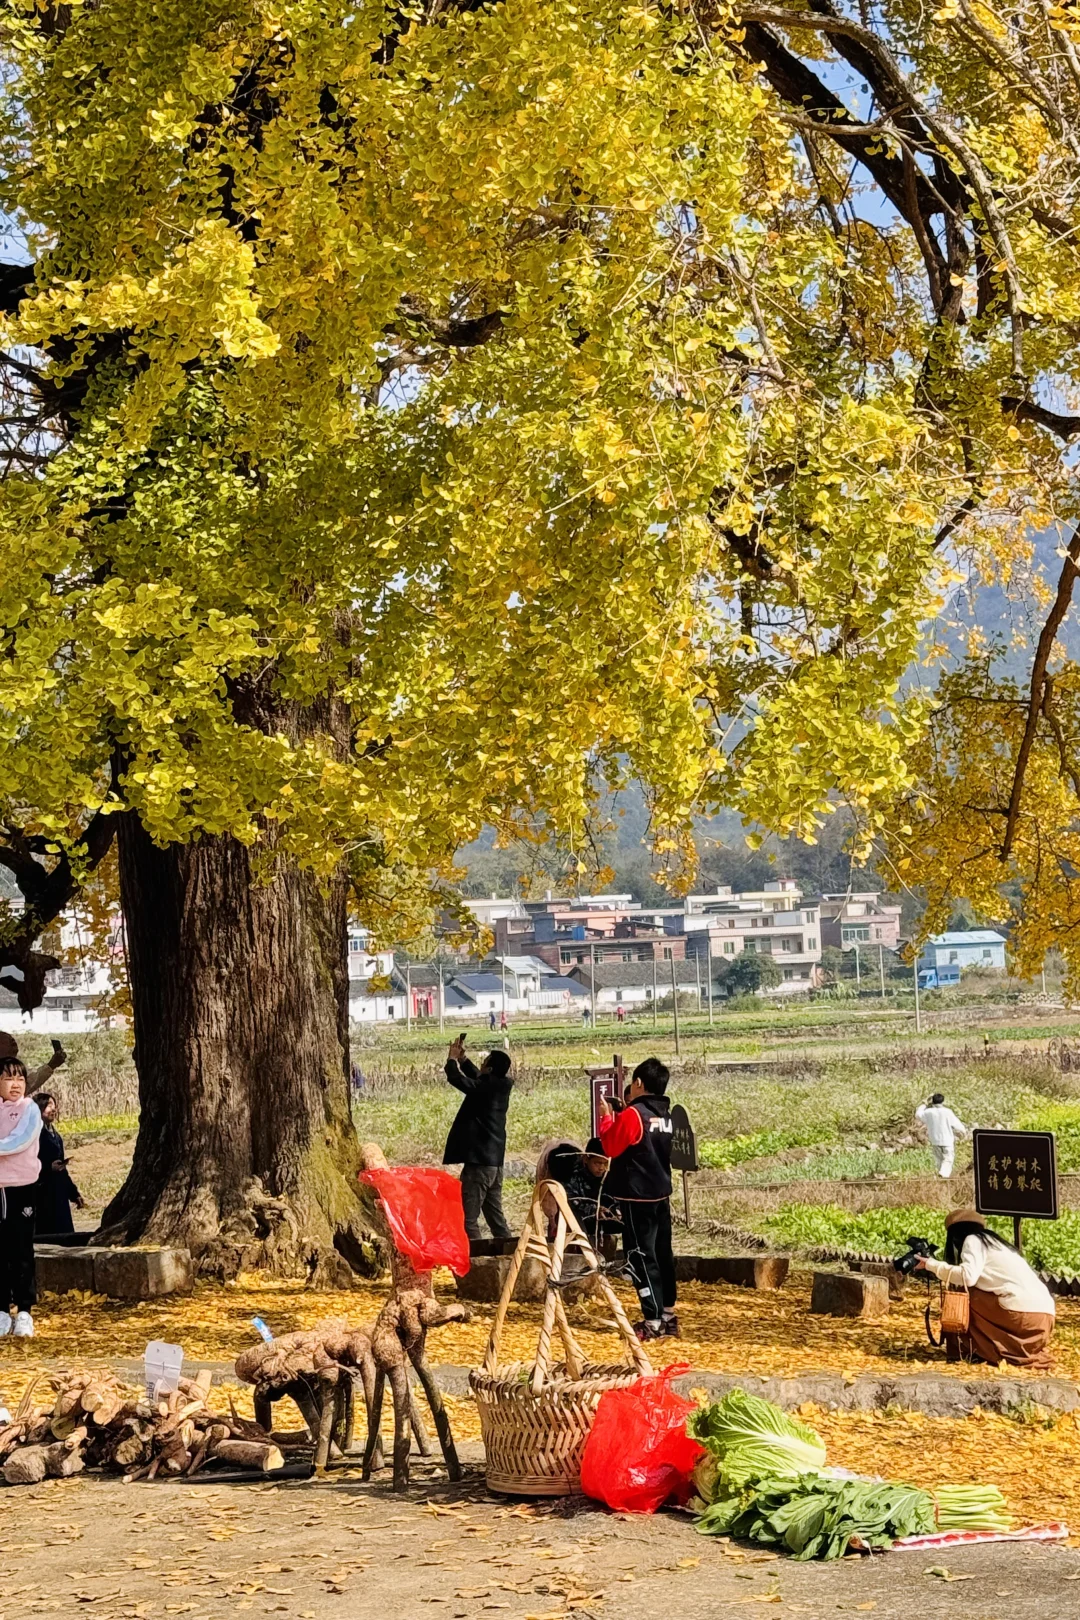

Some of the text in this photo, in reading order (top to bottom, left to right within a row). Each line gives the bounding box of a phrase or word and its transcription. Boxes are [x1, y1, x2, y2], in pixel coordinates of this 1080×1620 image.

[988, 1155, 1042, 1174] 爱护树木
[987, 1173, 1043, 1192] 请勿攀爬
